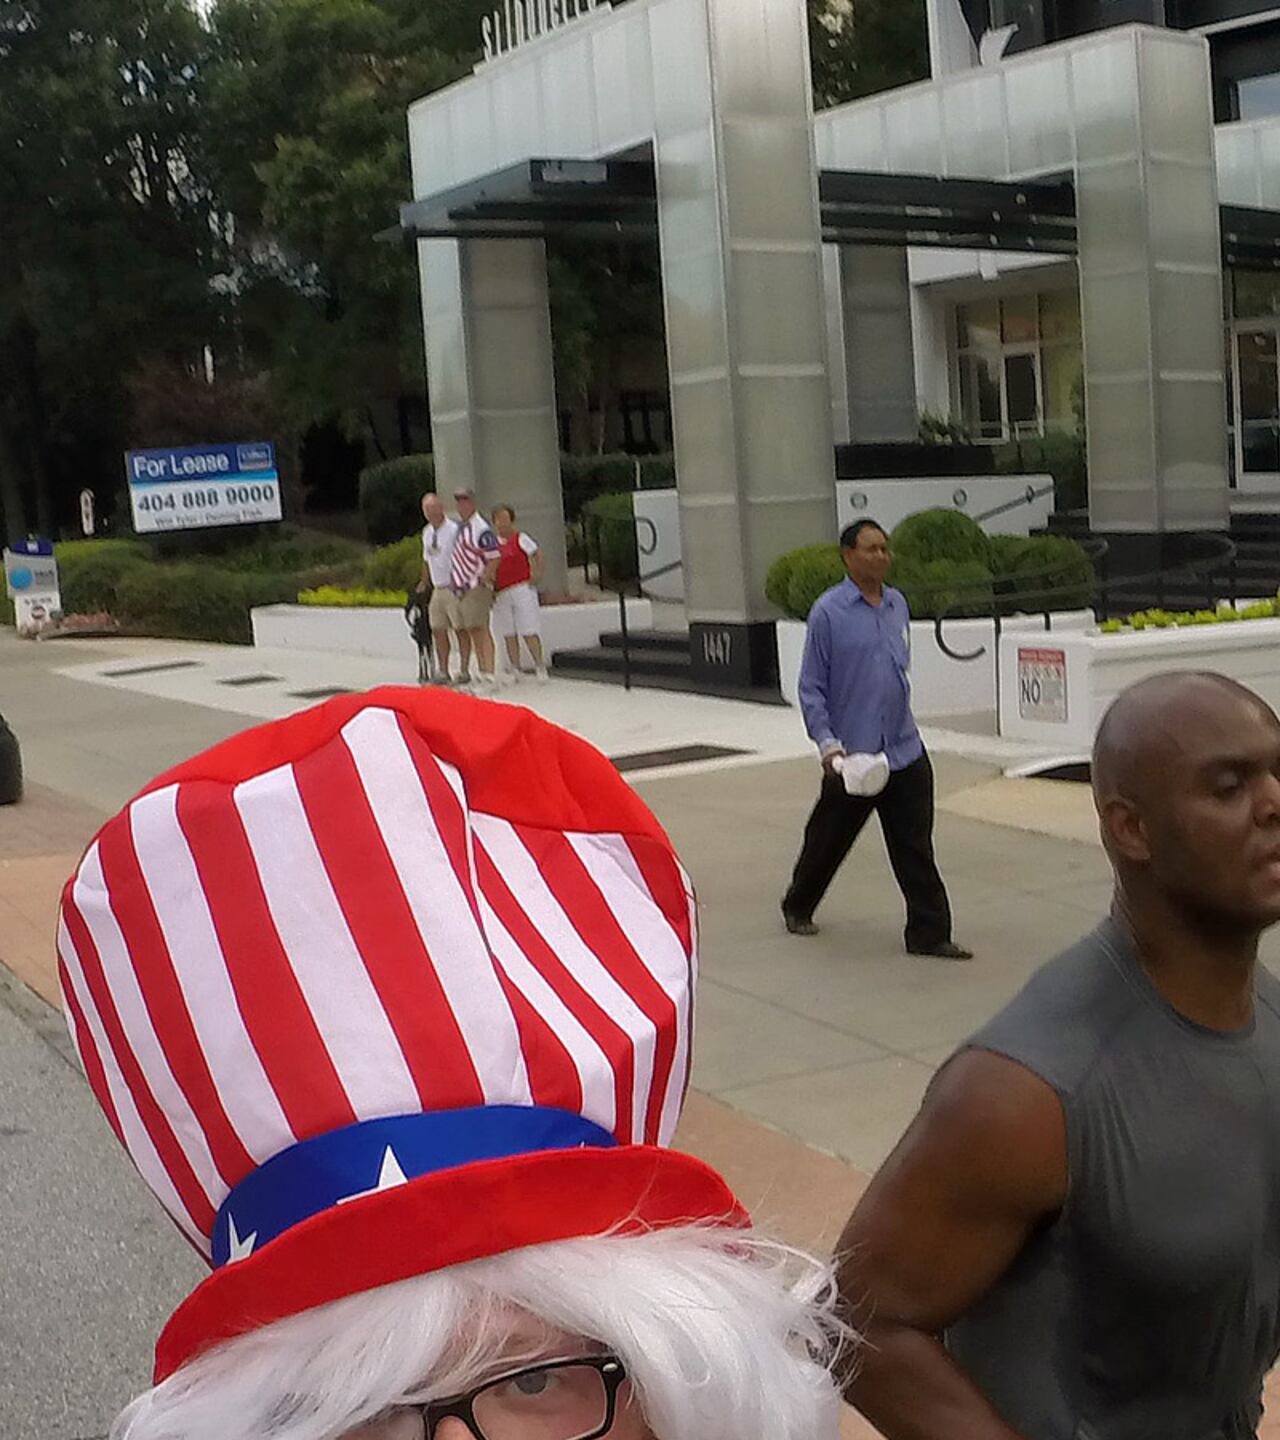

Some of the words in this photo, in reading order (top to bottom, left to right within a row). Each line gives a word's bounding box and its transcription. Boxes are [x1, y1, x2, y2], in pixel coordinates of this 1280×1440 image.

[133, 456, 167, 479] For
[170, 453, 229, 476] Lease
[138, 493, 176, 512] 404
[226, 484, 275, 505] 9000
[1021, 678, 1040, 704] NO
